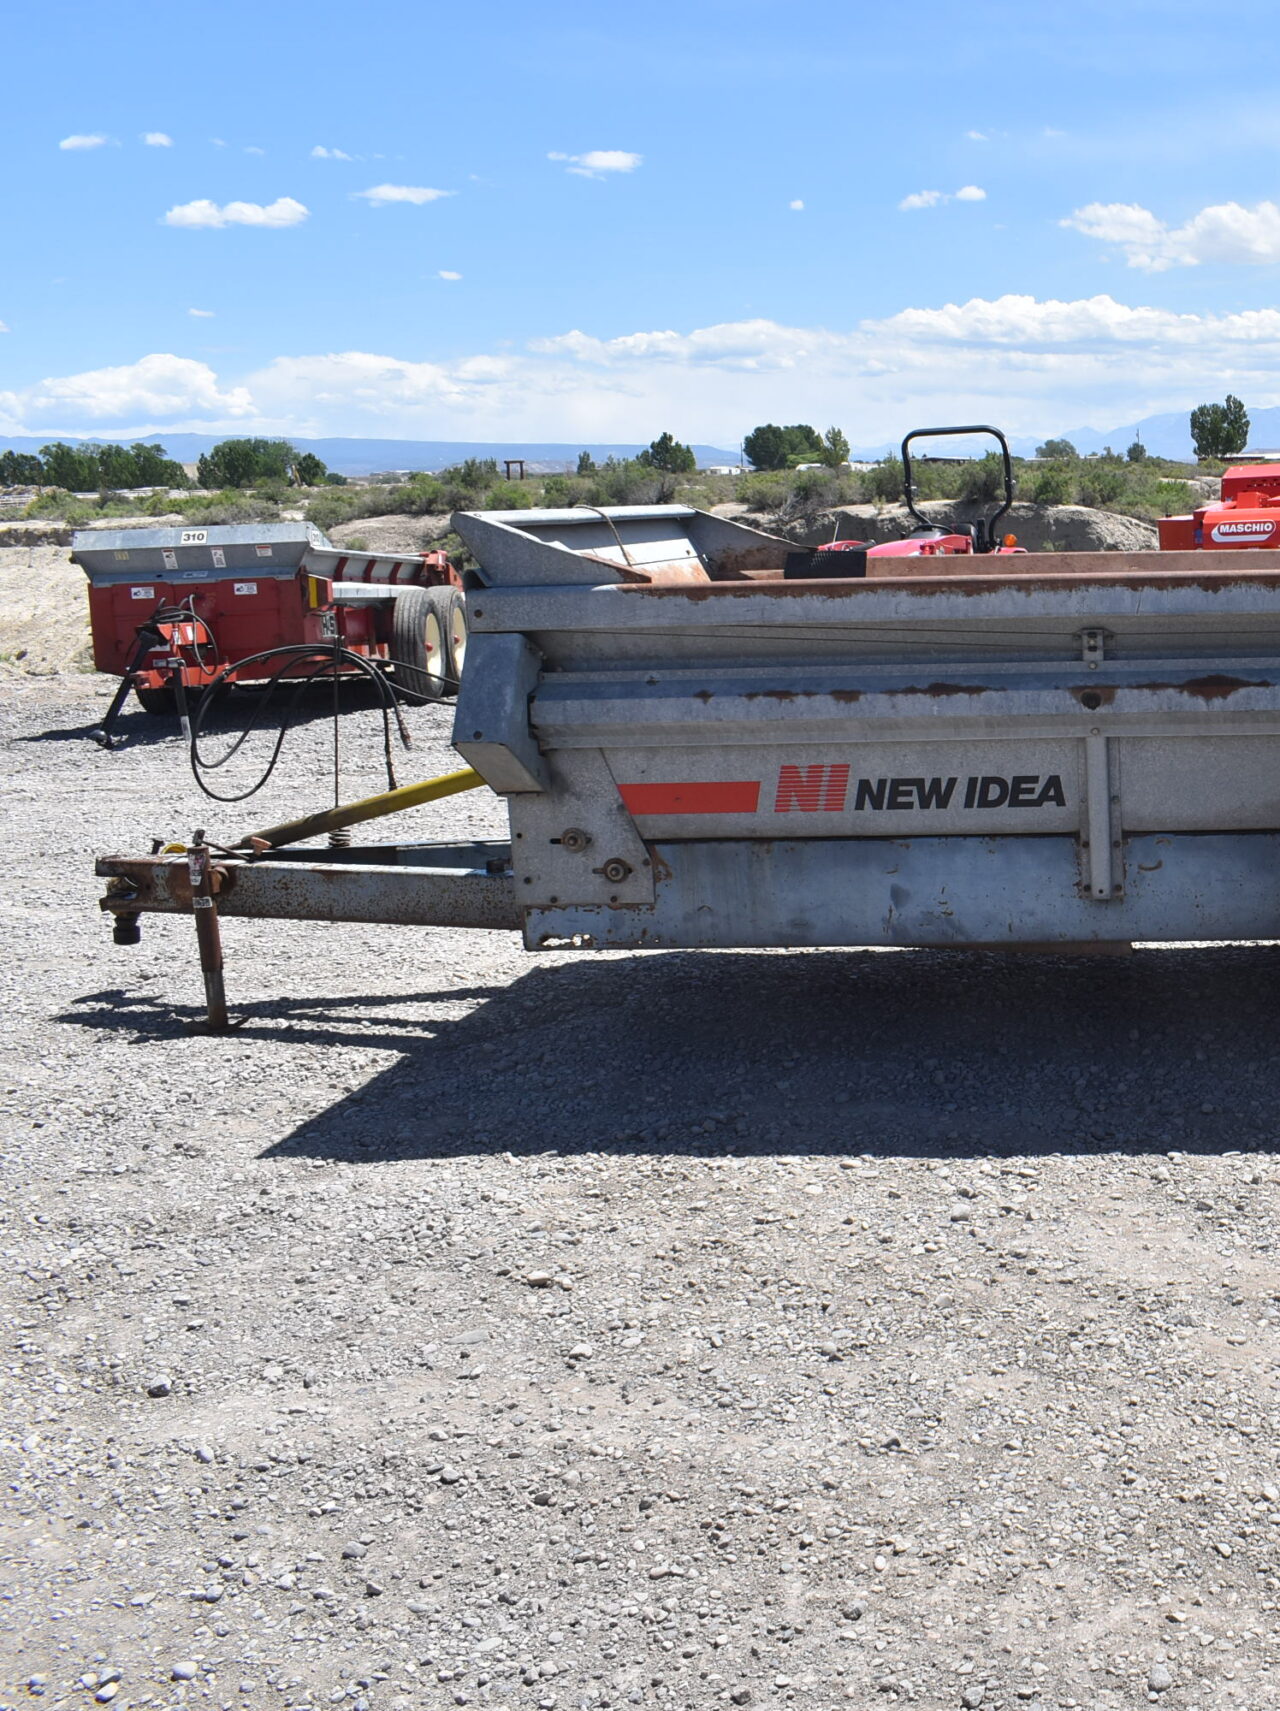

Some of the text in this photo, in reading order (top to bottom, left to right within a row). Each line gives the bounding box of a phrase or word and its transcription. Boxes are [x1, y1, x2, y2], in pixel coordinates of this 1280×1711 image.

[183, 533, 205, 542] 310
[1219, 523, 1273, 533] MASCHIO
[774, 764, 850, 812] NI
[854, 775, 1067, 810] NEW IDEA
